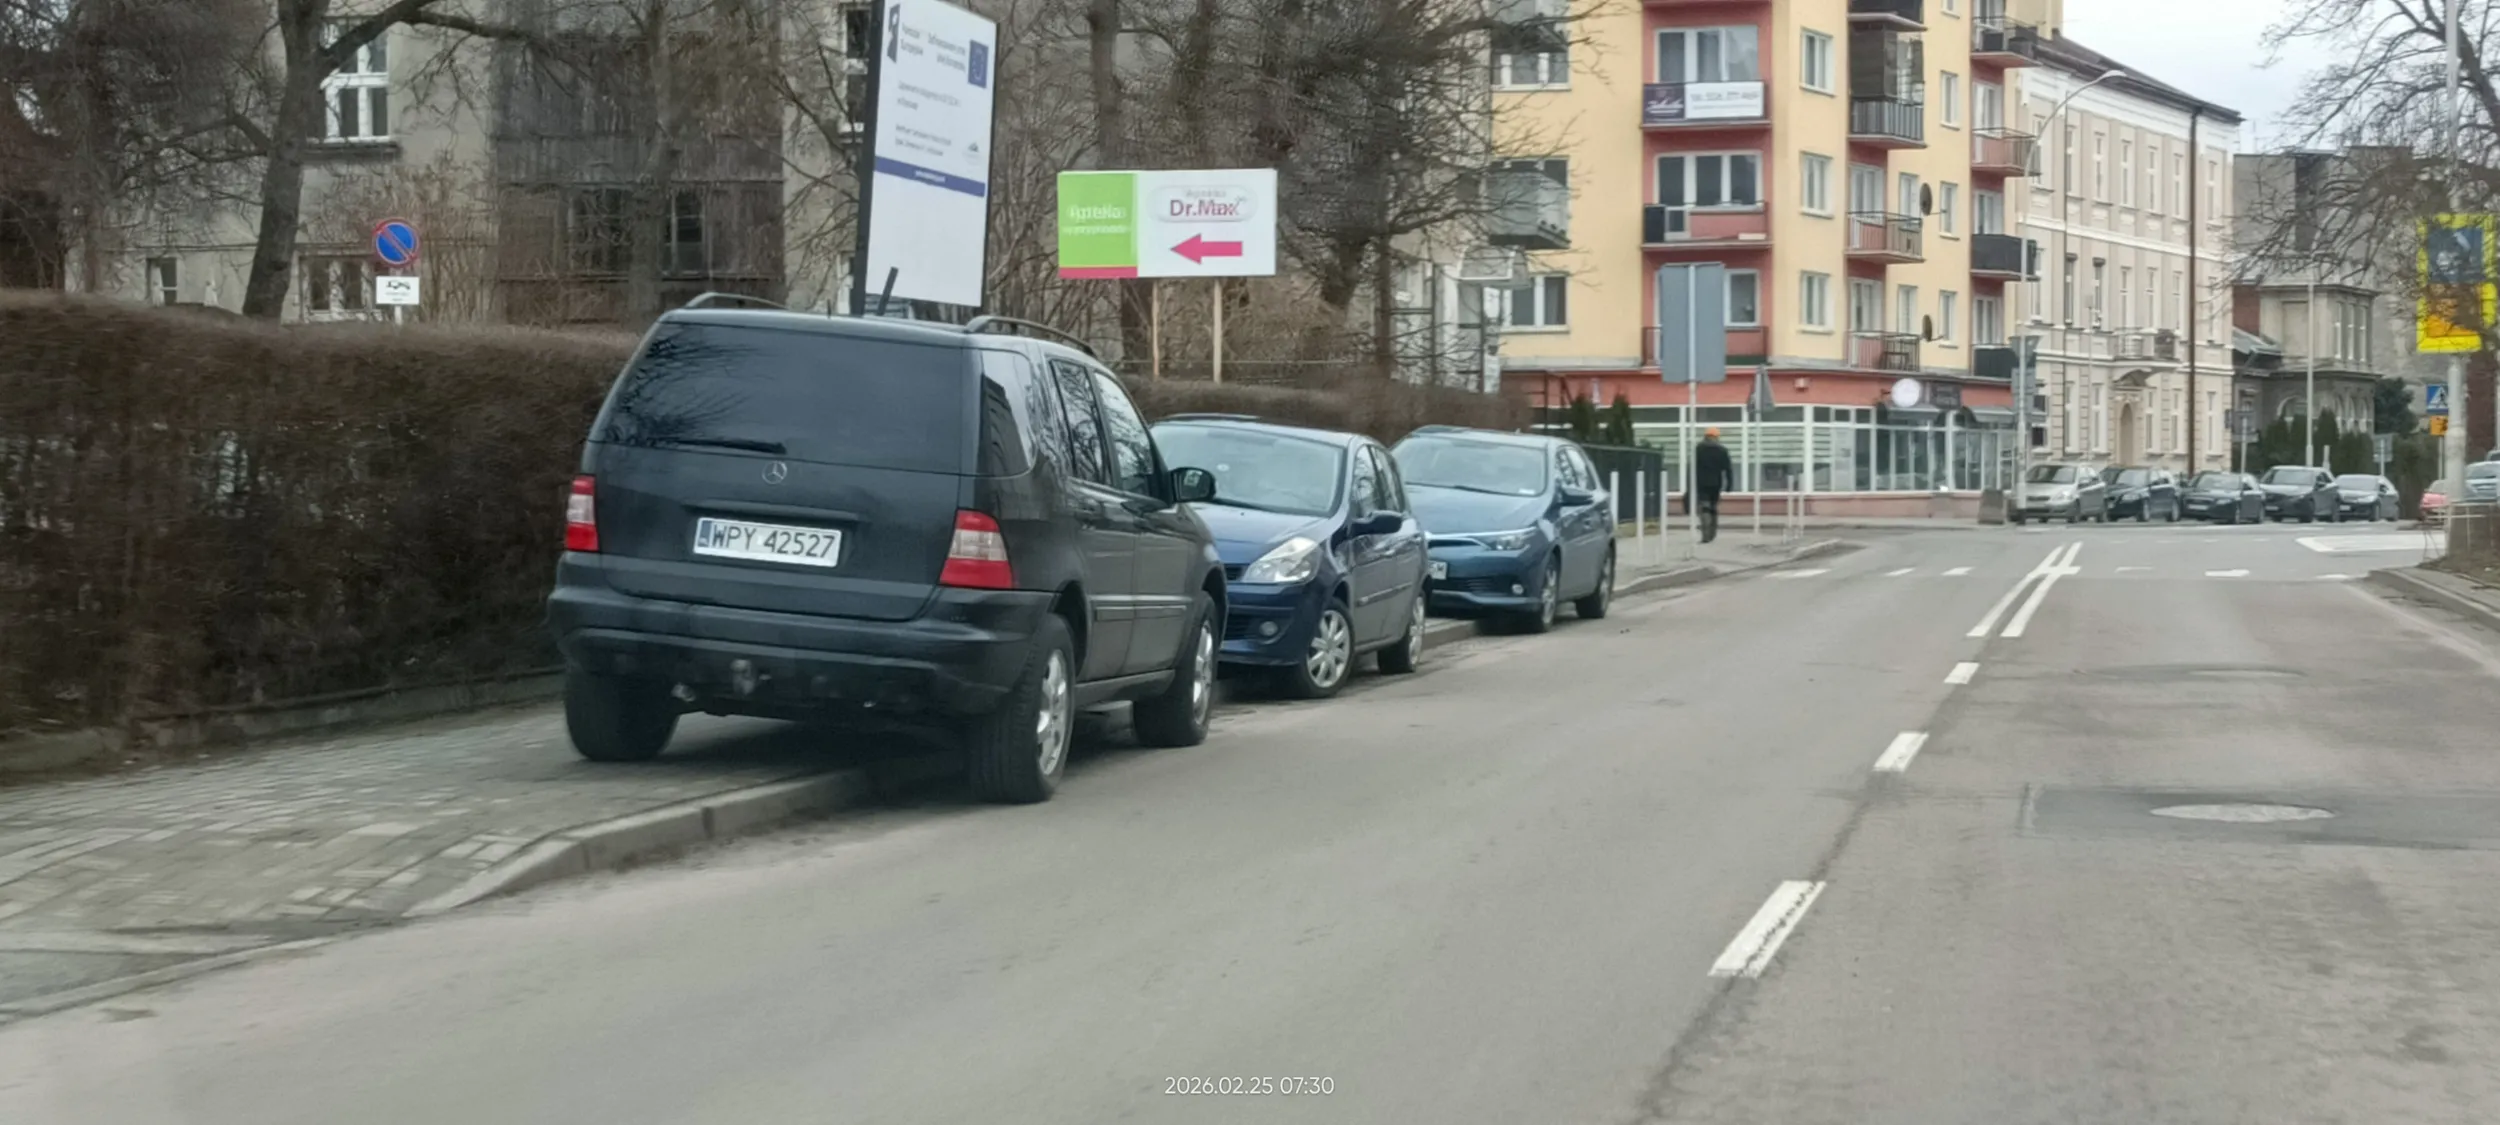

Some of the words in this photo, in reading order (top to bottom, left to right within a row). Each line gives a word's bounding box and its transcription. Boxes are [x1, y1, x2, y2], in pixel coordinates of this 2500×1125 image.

[1169, 198, 1241, 217] Dr.Max
[711, 524, 757, 551] WPY
[763, 530, 836, 559] 42527
